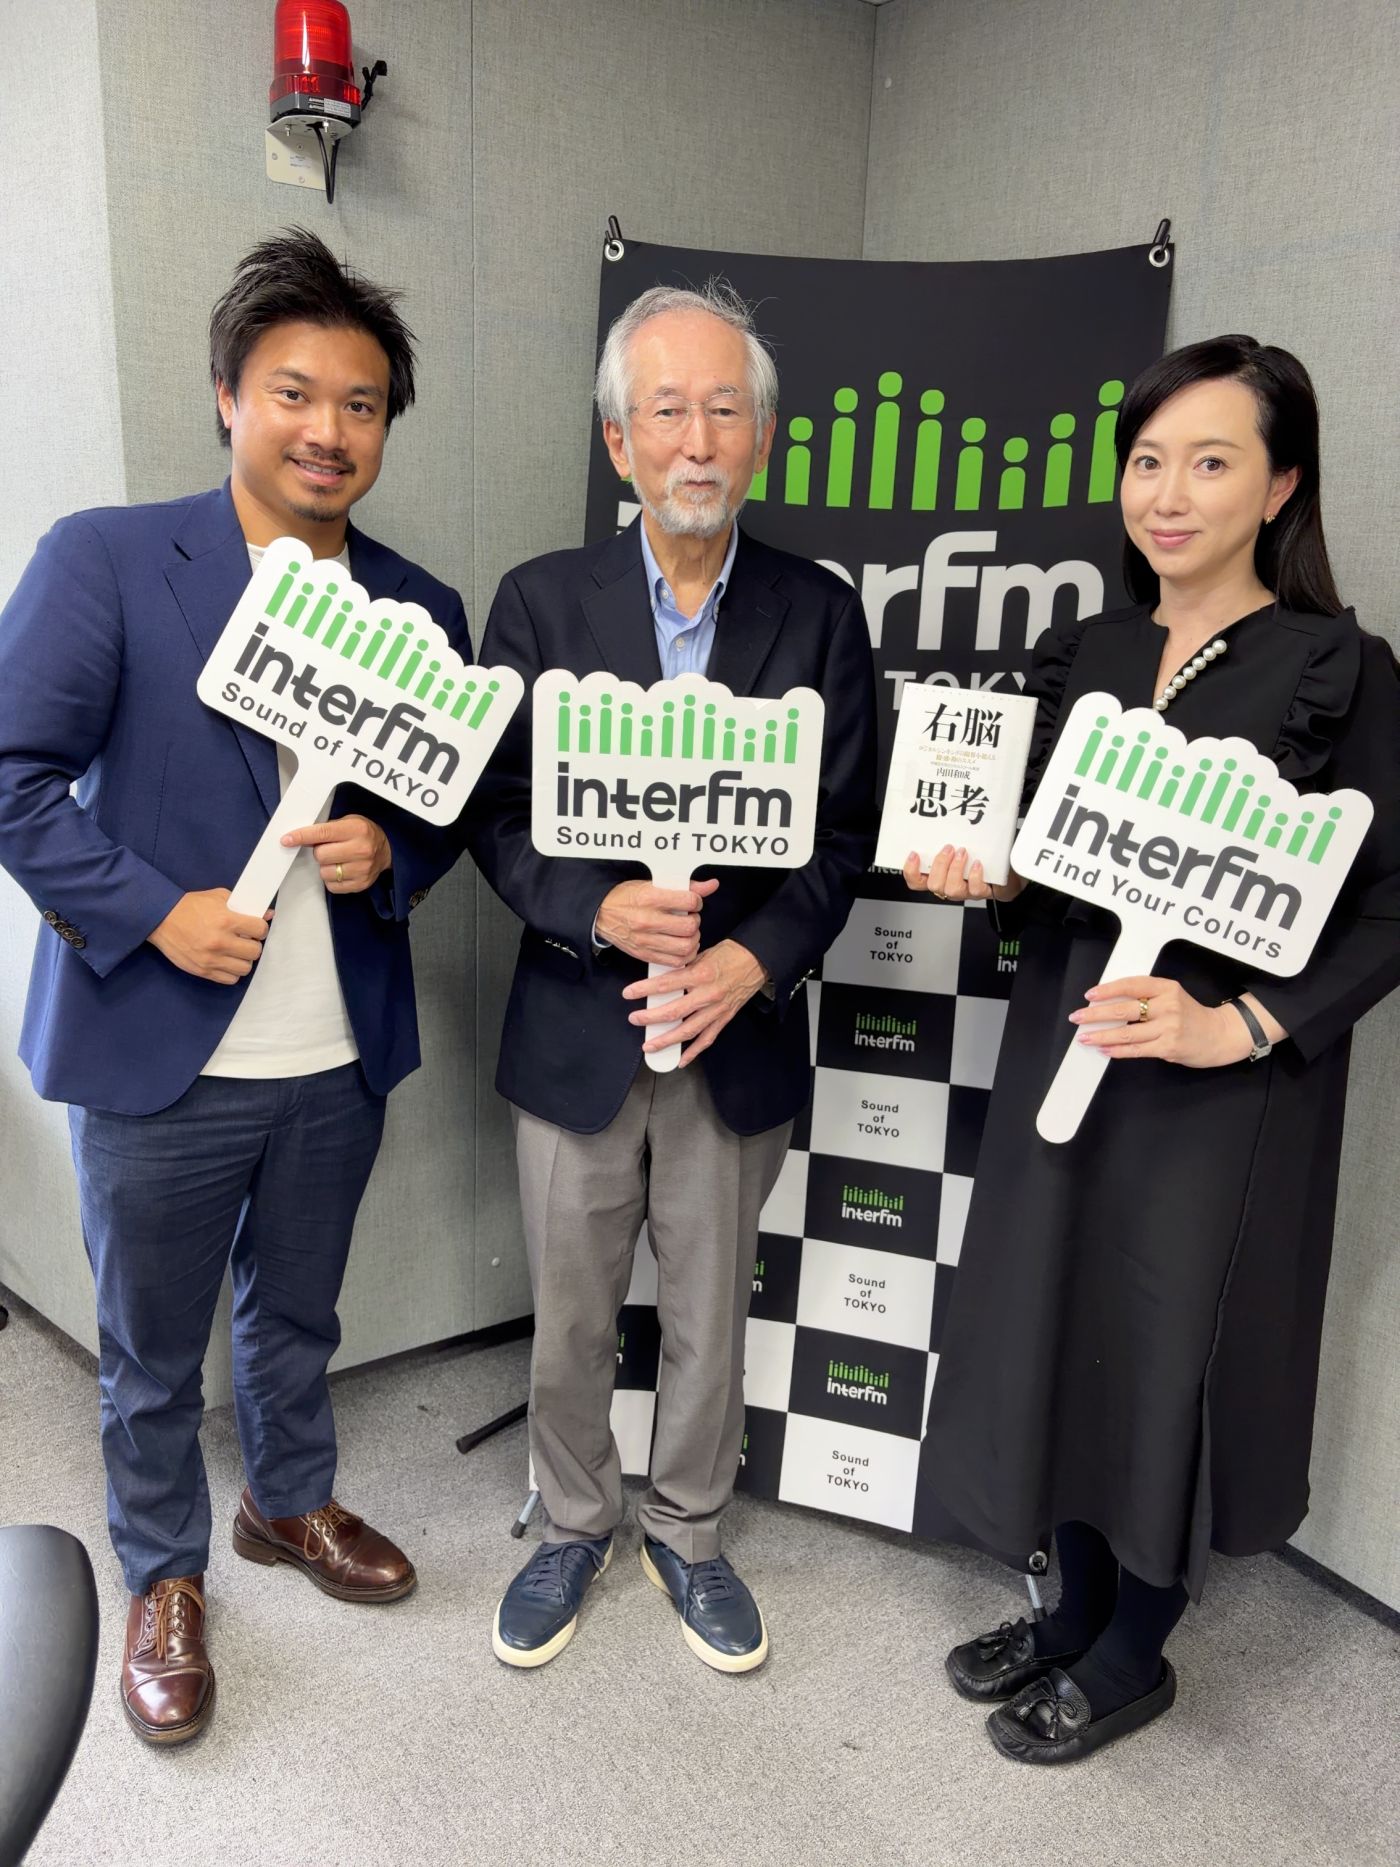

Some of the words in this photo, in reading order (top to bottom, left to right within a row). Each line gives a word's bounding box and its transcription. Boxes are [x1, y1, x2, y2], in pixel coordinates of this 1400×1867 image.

[233, 621, 460, 785] interfm
[922, 703, 1004, 748] 右脳
[221, 681, 308, 739] Sound
[313, 735, 343, 756] of
[350, 748, 440, 808] TOKYO
[557, 761, 792, 828] interfm
[910, 779, 990, 825] 思考
[556, 826, 642, 849] Sound
[654, 832, 680, 850] of
[692, 833, 789, 856] TOKYO
[1046, 783, 1302, 931] interfm
[1034, 848, 1101, 888] Find
[1111, 874, 1176, 916] Your
[1183, 905, 1282, 959] Colors
[874, 926, 912, 939] Sound
[886, 941, 898, 950] of
[870, 950, 913, 963] TOKYO
[854, 1029, 915, 1052] interfm
[861, 1100, 899, 1113] Sound
[872, 1115, 885, 1123] of
[857, 1123, 900, 1138] TOKYO
[841, 1202, 903, 1228] interfm
[848, 1273, 886, 1289] Sound
[859, 1290, 872, 1298] of
[844, 1297, 886, 1313] TOKYO
[826, 1377, 888, 1405] interfm
[832, 1450, 869, 1467] Sound
[843, 1467, 855, 1476] of
[827, 1474, 869, 1492] TOKYO
